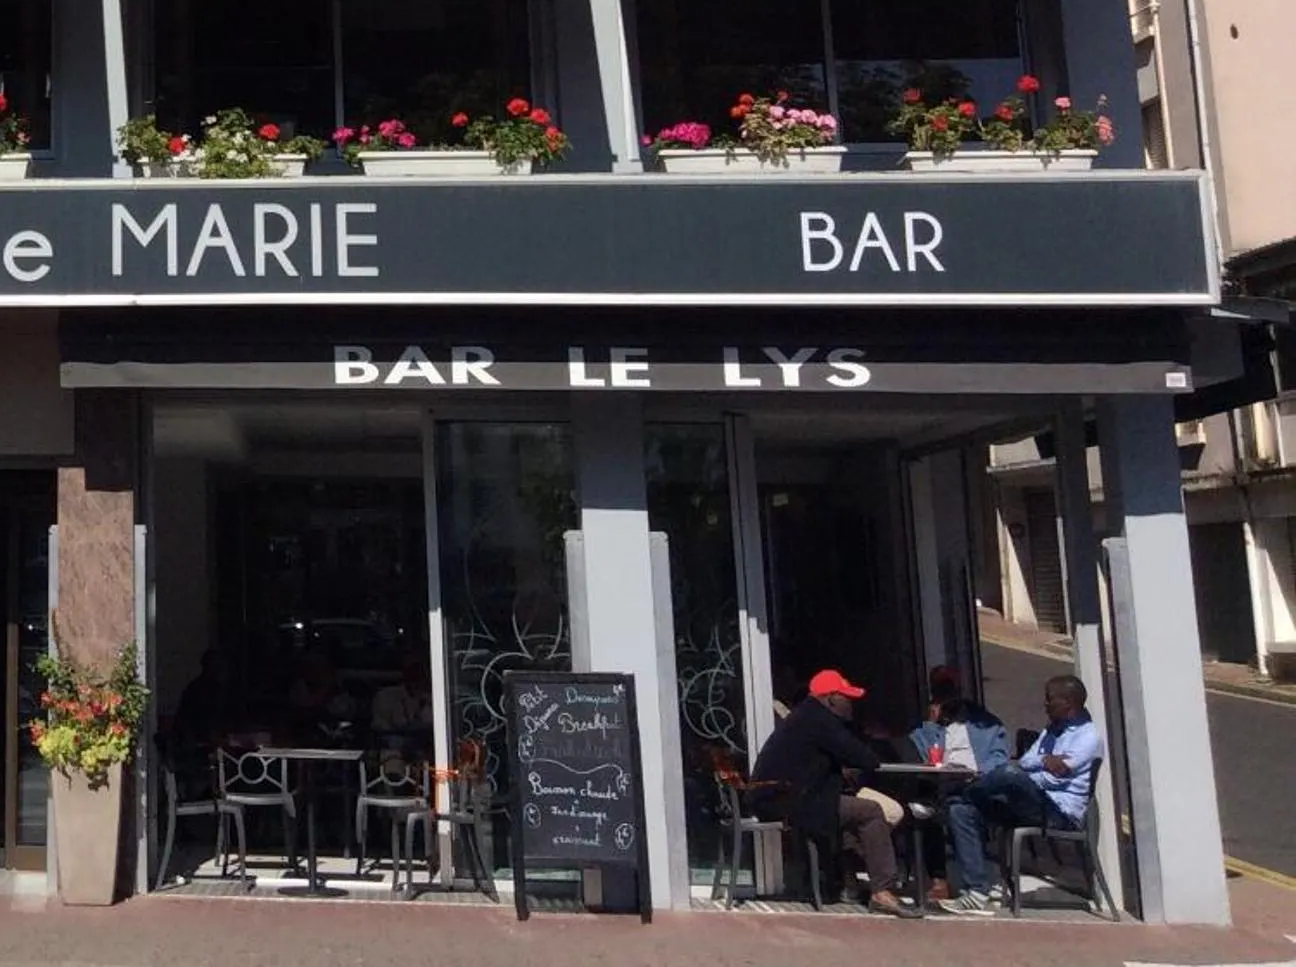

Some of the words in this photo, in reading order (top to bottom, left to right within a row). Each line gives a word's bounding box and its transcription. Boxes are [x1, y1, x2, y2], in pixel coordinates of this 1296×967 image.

[111, 202, 379, 278] MARIE
[800, 211, 945, 275] BAR
[333, 345, 501, 387] BAR
[568, 346, 652, 390] LE
[722, 347, 872, 390] LYS
